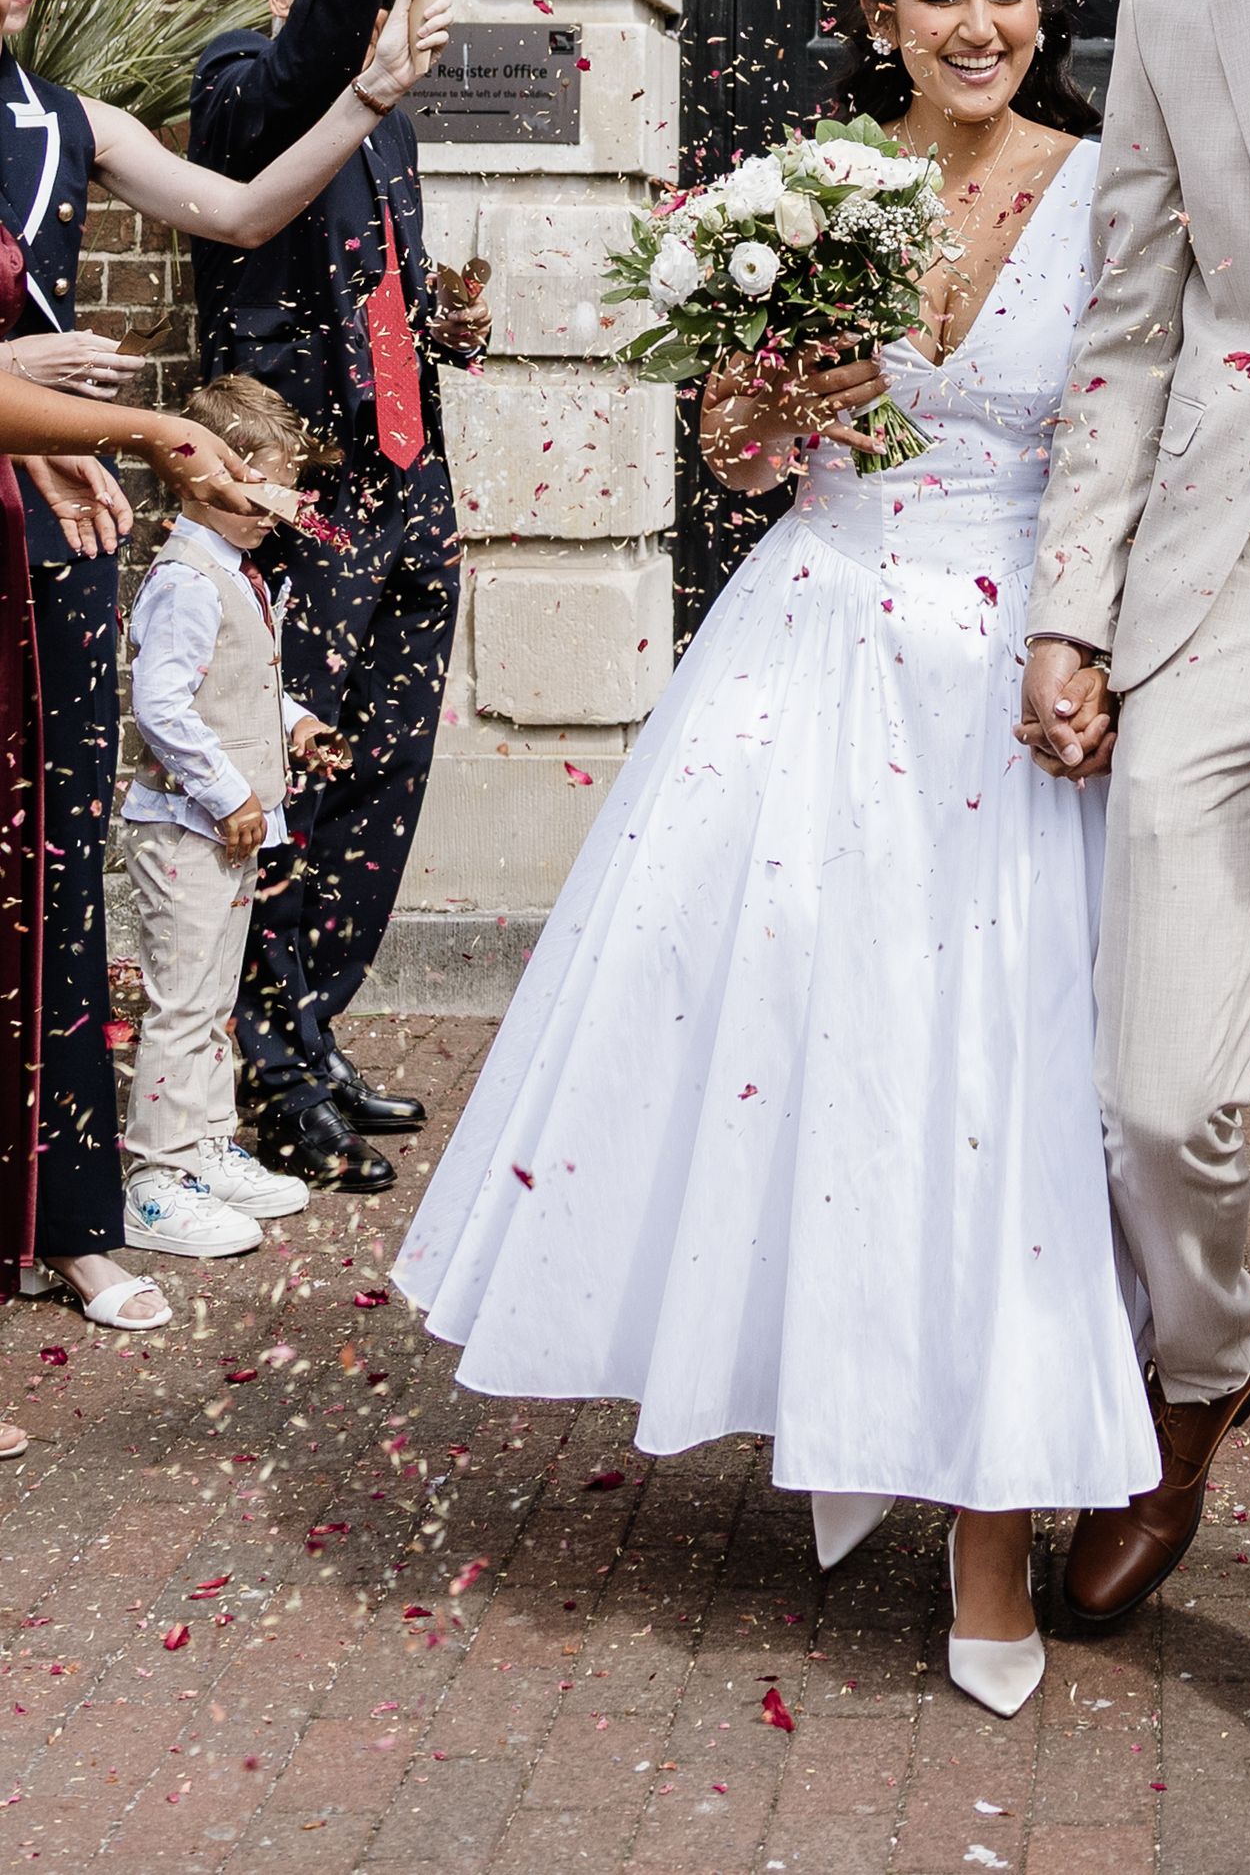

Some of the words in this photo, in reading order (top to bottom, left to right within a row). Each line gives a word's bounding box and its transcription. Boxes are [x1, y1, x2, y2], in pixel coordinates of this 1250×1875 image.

[438, 64, 499, 82] Register
[503, 64, 548, 79] Office
[413, 89, 447, 98] entrance
[450, 89, 458, 98] to
[460, 89, 473, 98] the
[476, 89, 491, 98] left
[493, 89, 501, 98] of
[504, 89, 516, 98] the
